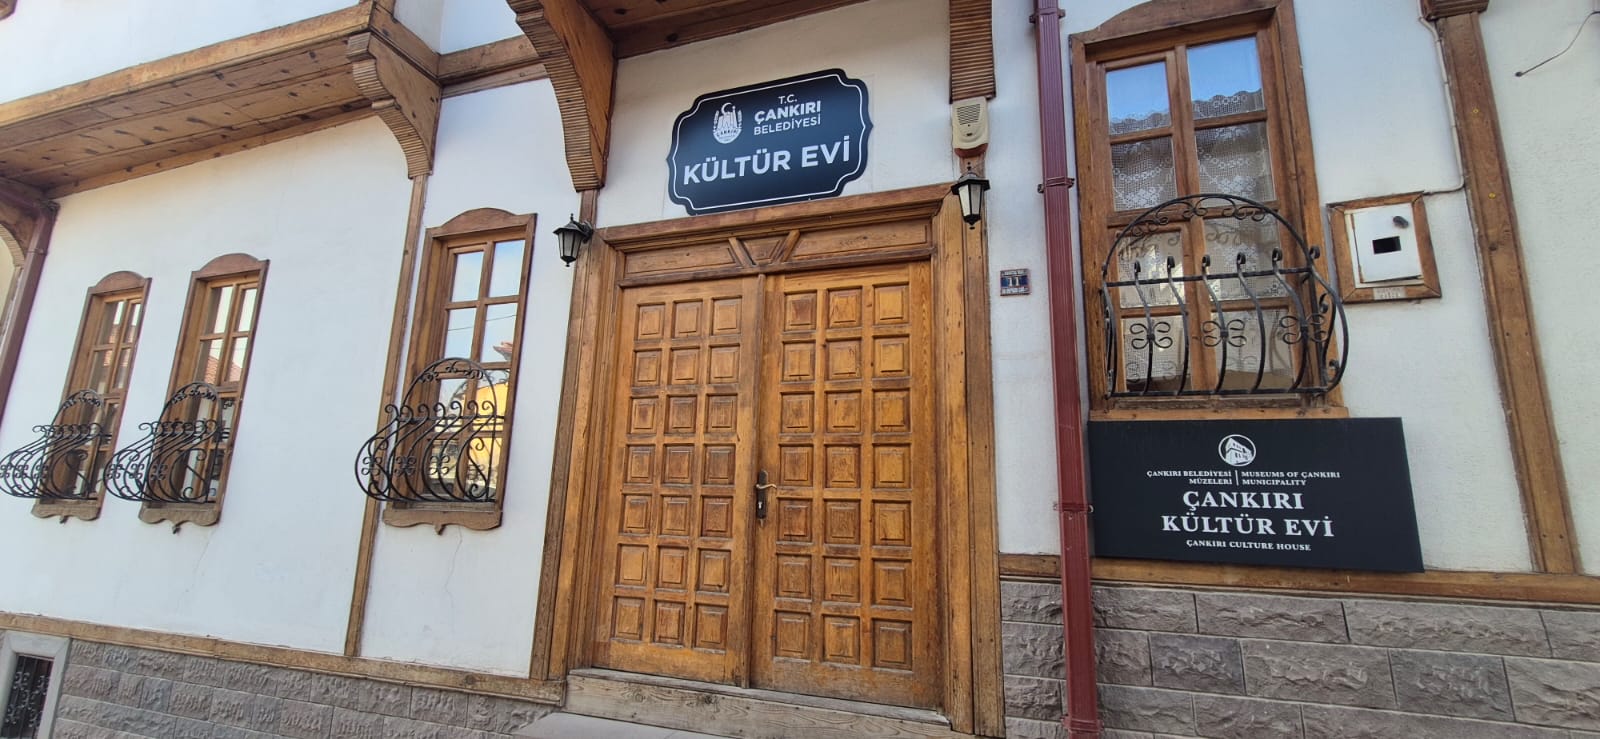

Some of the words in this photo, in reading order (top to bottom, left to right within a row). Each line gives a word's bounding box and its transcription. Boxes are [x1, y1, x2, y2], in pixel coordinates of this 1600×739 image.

[778, 94, 798, 105] T.C.
[754, 101, 821, 125] ÇANKIRI
[754, 116, 821, 136] BELEDİYESİ
[683, 149, 791, 185] KÜLTÜR
[801, 135, 850, 168] EVİ
[1008, 276, 1019, 287] 11
[1146, 470, 1182, 478] ÇANKIRI
[1241, 470, 1285, 478] MUSEUMS
[1301, 471, 1341, 479] ÇANKIRI
[1189, 477, 1233, 485] MÜZELERİ
[1242, 478, 1308, 486] MUNICIPALITY
[1182, 490, 1305, 511] ÇANKIRI
[1161, 512, 1277, 535] KÜLTÜR
[1284, 515, 1335, 537] EVİ
[1186, 539, 1227, 548] ÇANKIRI
[1229, 541, 1274, 550] CULTURE
[1276, 543, 1312, 551] HOUSE
